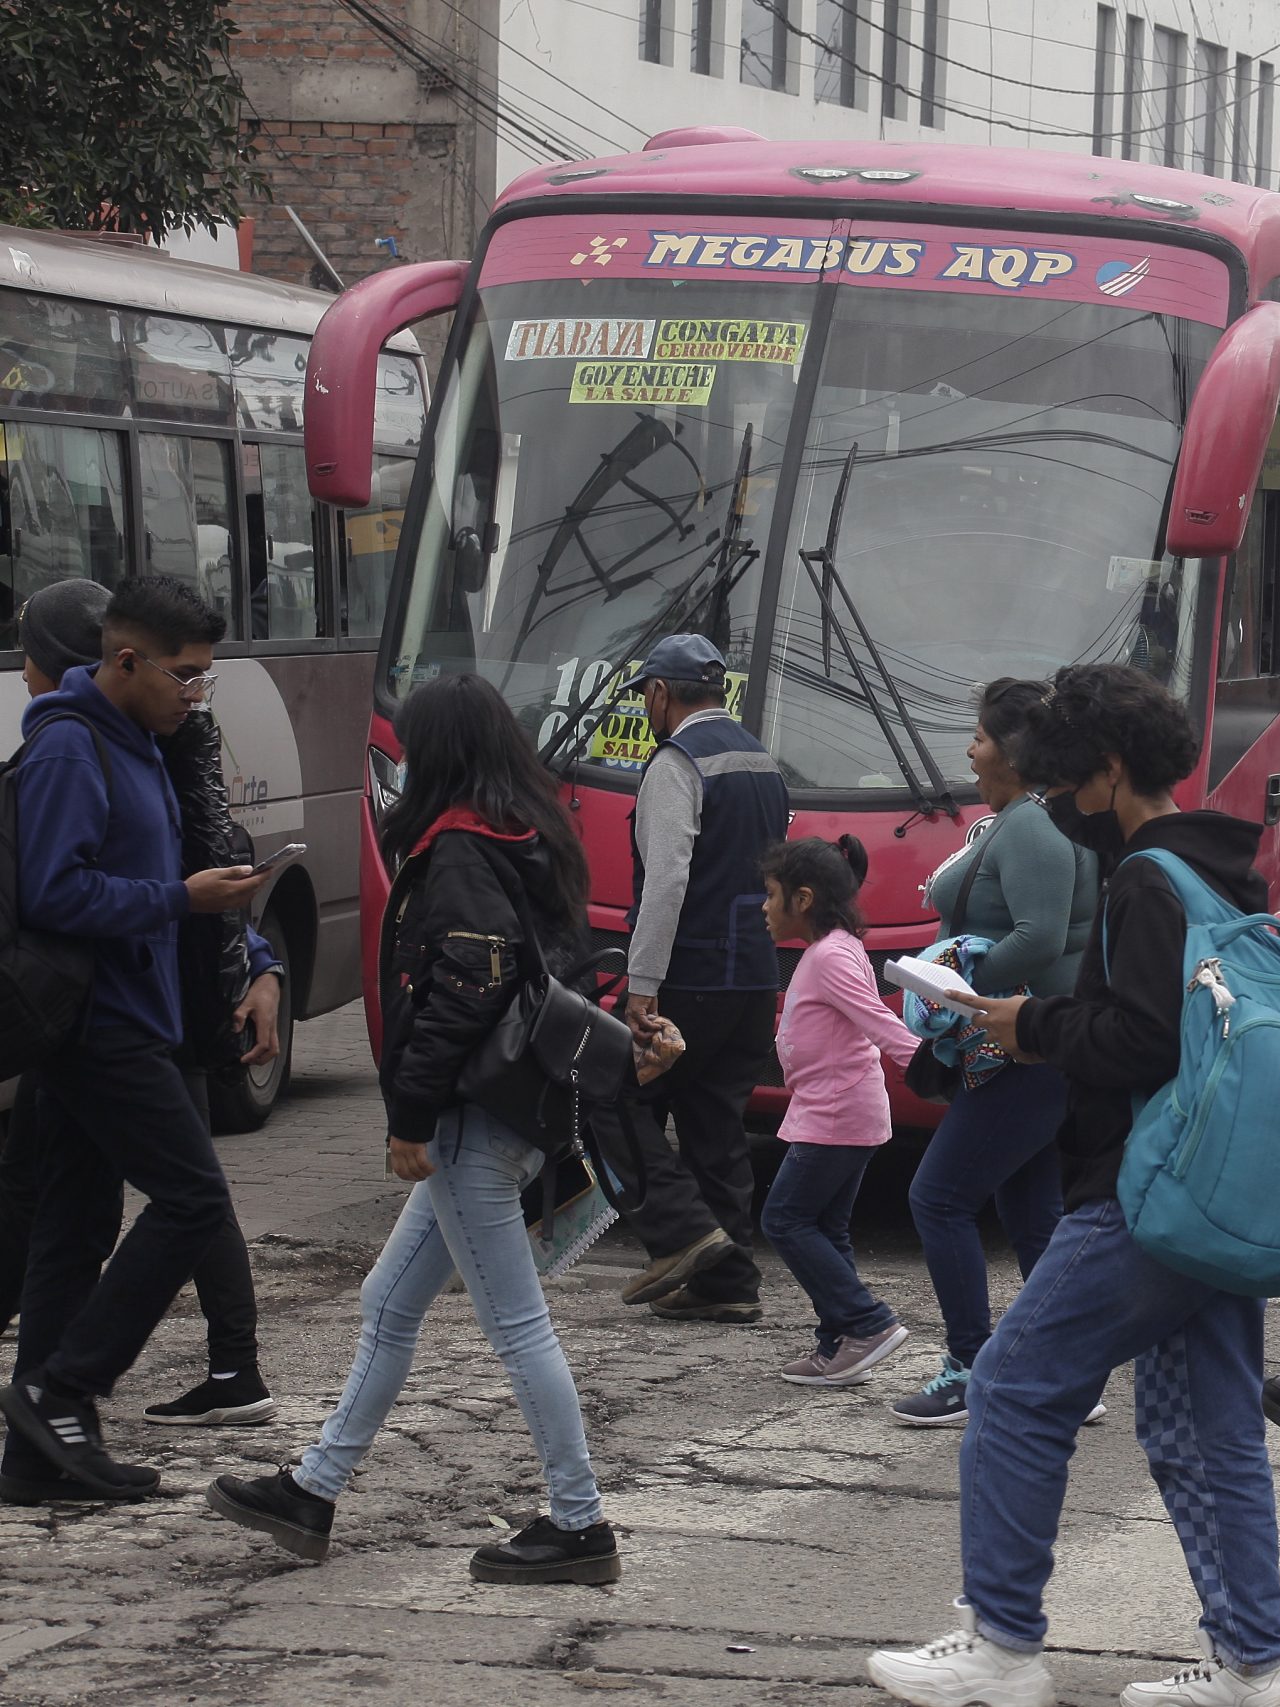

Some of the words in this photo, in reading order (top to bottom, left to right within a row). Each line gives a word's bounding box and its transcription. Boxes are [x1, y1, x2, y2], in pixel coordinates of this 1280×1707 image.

[647, 233, 923, 276] MEGABUS
[942, 247, 1074, 288] AQP
[515, 321, 645, 357] TIABAYA
[661, 321, 798, 345] CONGATA
[579, 365, 713, 388] GOYENECHE
[584, 387, 615, 401] LA
[621, 387, 693, 402] SALLE
